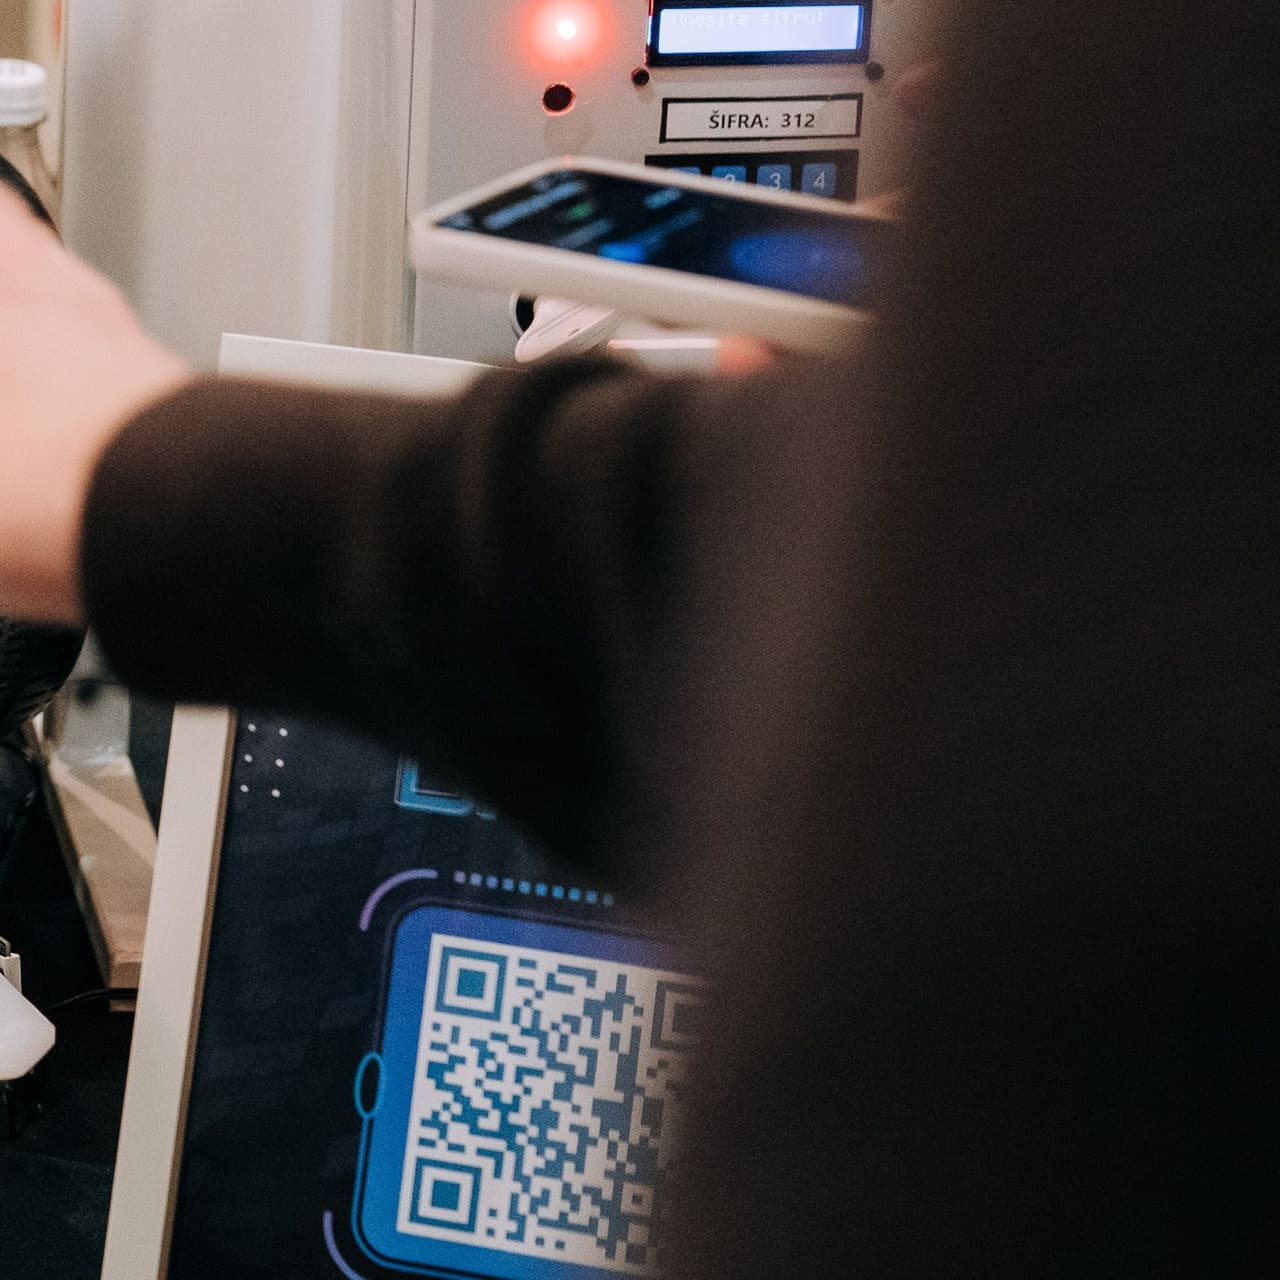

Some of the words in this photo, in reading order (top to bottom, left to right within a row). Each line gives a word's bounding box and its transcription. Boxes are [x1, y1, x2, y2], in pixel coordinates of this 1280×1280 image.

[708, 109, 769, 131] ŠIFRA:
[780, 113, 816, 129] 312
[770, 172, 781, 190] 3
[813, 171, 825, 190] 4
